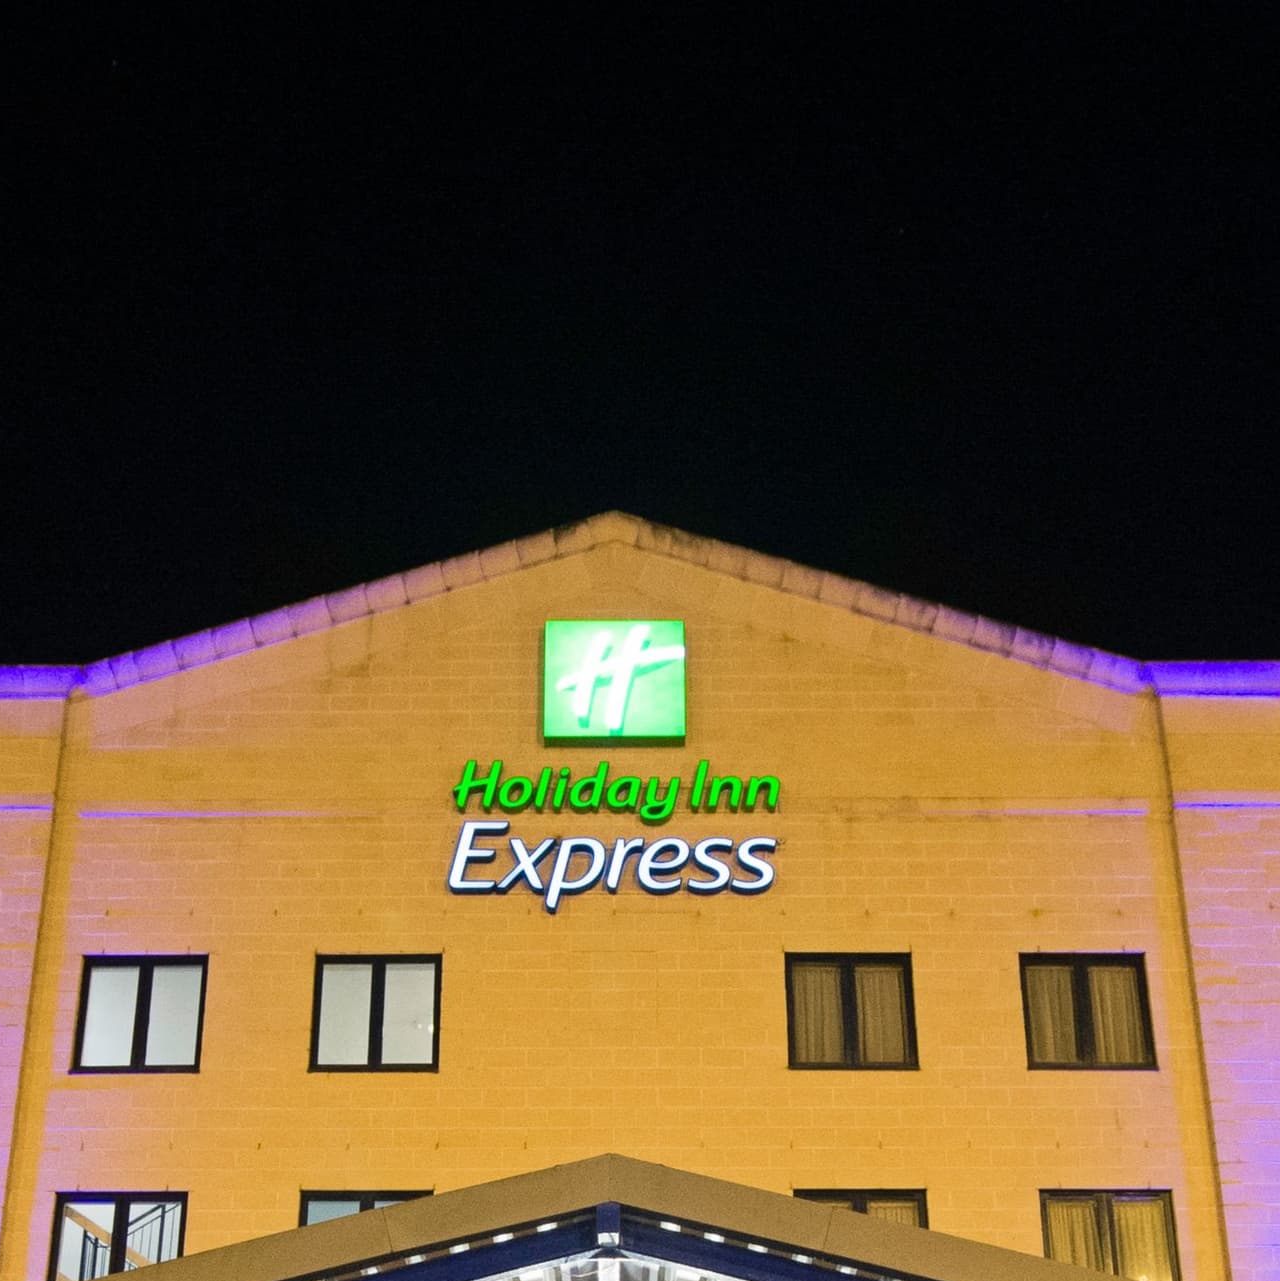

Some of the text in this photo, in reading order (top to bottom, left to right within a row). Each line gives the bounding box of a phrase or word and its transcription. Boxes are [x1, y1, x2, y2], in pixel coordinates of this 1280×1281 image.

[453, 759, 781, 823] Holiday Inn
[448, 820, 778, 914] Express
